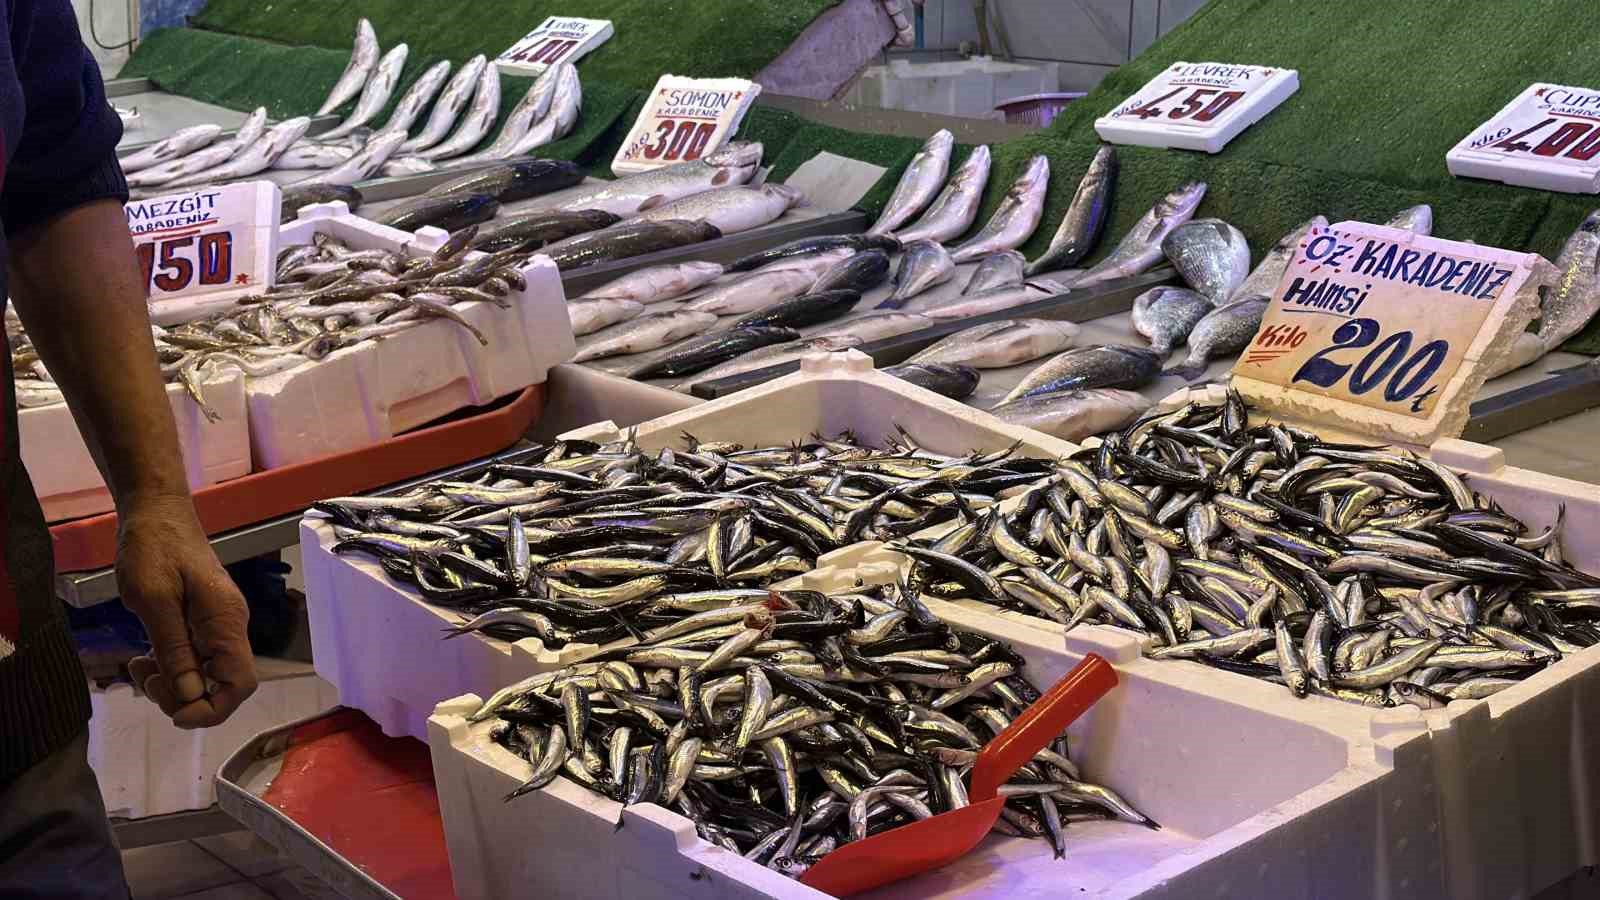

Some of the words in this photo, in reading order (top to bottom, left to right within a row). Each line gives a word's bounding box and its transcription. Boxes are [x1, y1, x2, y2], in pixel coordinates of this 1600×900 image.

[510, 38, 579, 65] 400
[1180, 66, 1257, 80] LEVREK
[665, 89, 734, 109] SOMON
[1122, 86, 1246, 122] 450
[643, 119, 718, 161] 300
[126, 192, 221, 222] MEZGİT
[1351, 239, 1513, 300] KARADENİZ
[1256, 324, 1308, 348] Kilo
